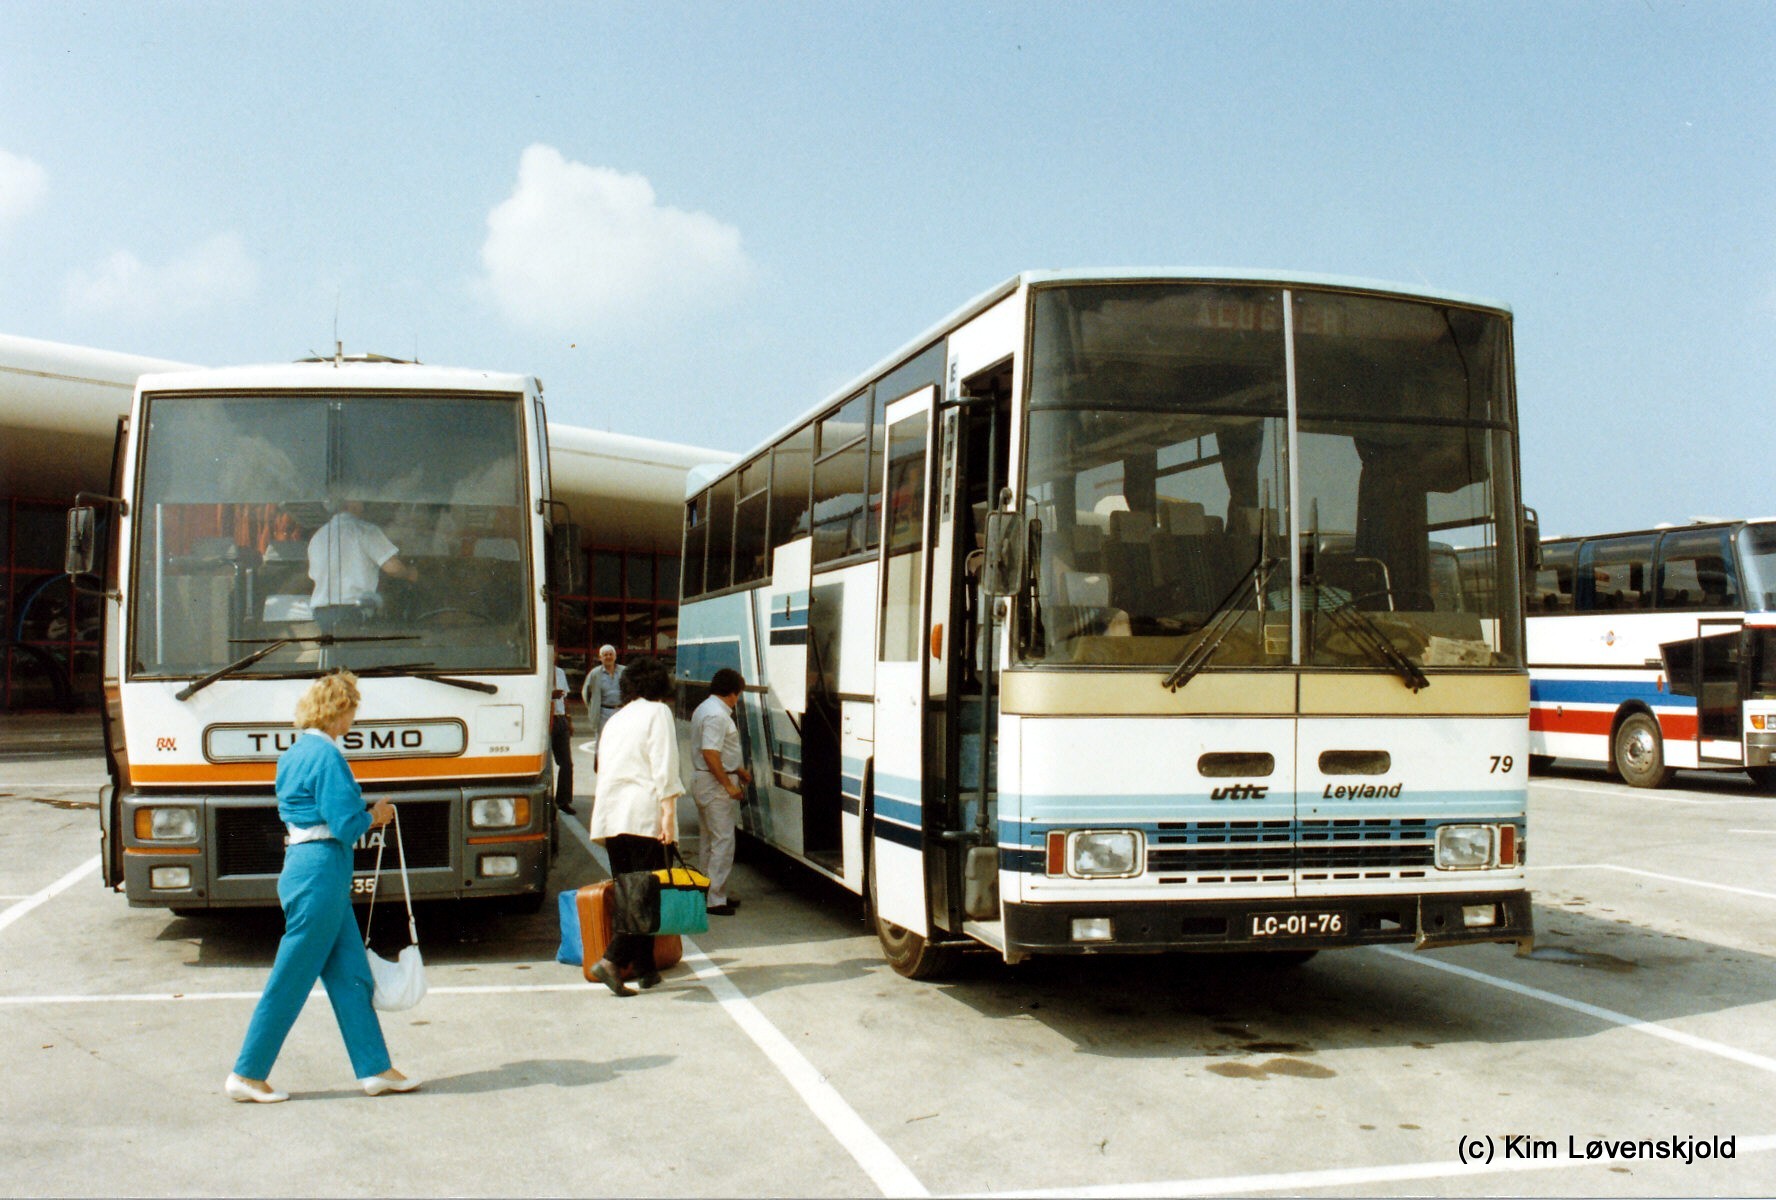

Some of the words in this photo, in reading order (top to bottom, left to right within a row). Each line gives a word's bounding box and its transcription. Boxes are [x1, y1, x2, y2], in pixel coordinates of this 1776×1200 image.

[248, 730, 422, 752] TUSMO
[1490, 755, 1513, 773] 79
[1323, 783, 1402, 801] Leyland
[1253, 914, 1342, 935] LC-01-76
